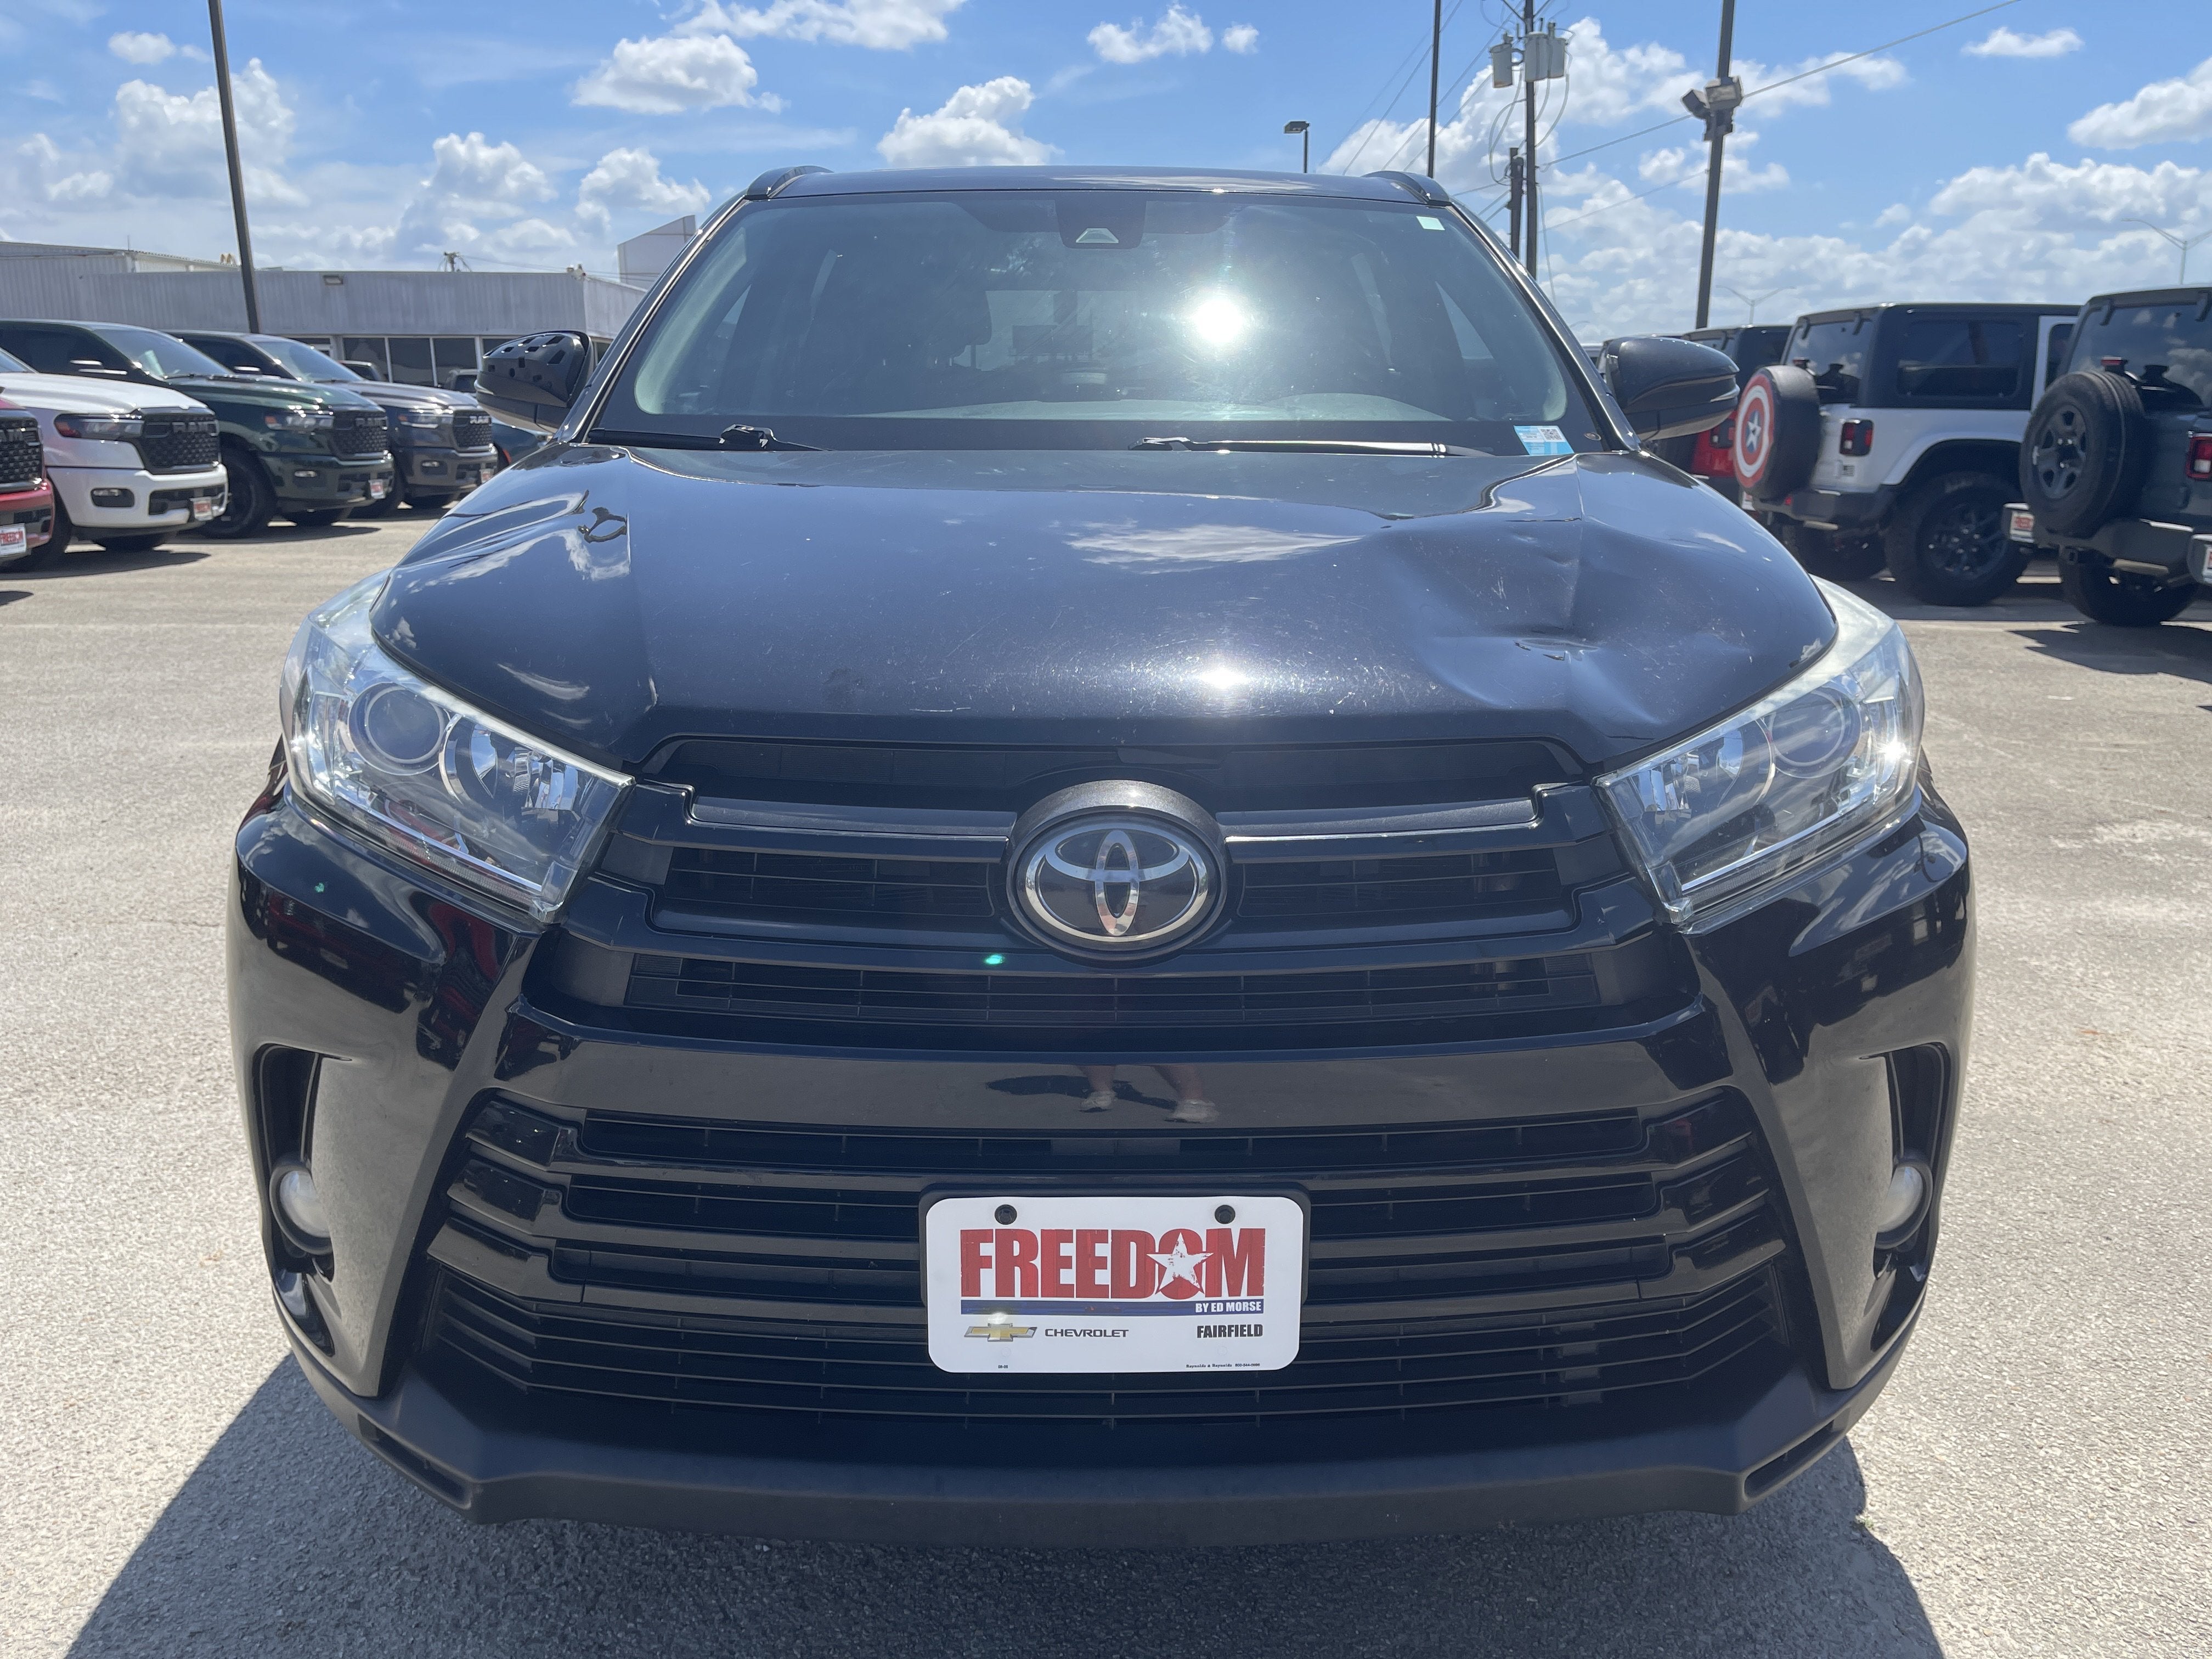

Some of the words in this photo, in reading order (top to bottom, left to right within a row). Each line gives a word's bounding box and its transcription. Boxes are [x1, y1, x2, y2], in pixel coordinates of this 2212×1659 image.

[960, 1228, 1265, 1300] FREEDOM
[1195, 1303, 1209, 1312] BY
[1211, 1302, 1223, 1312] ED
[1226, 1301, 1261, 1312] MORSE
[1045, 1329, 1129, 1338] CHEVROLET
[1197, 1324, 1263, 1338] FAIRFIELD
